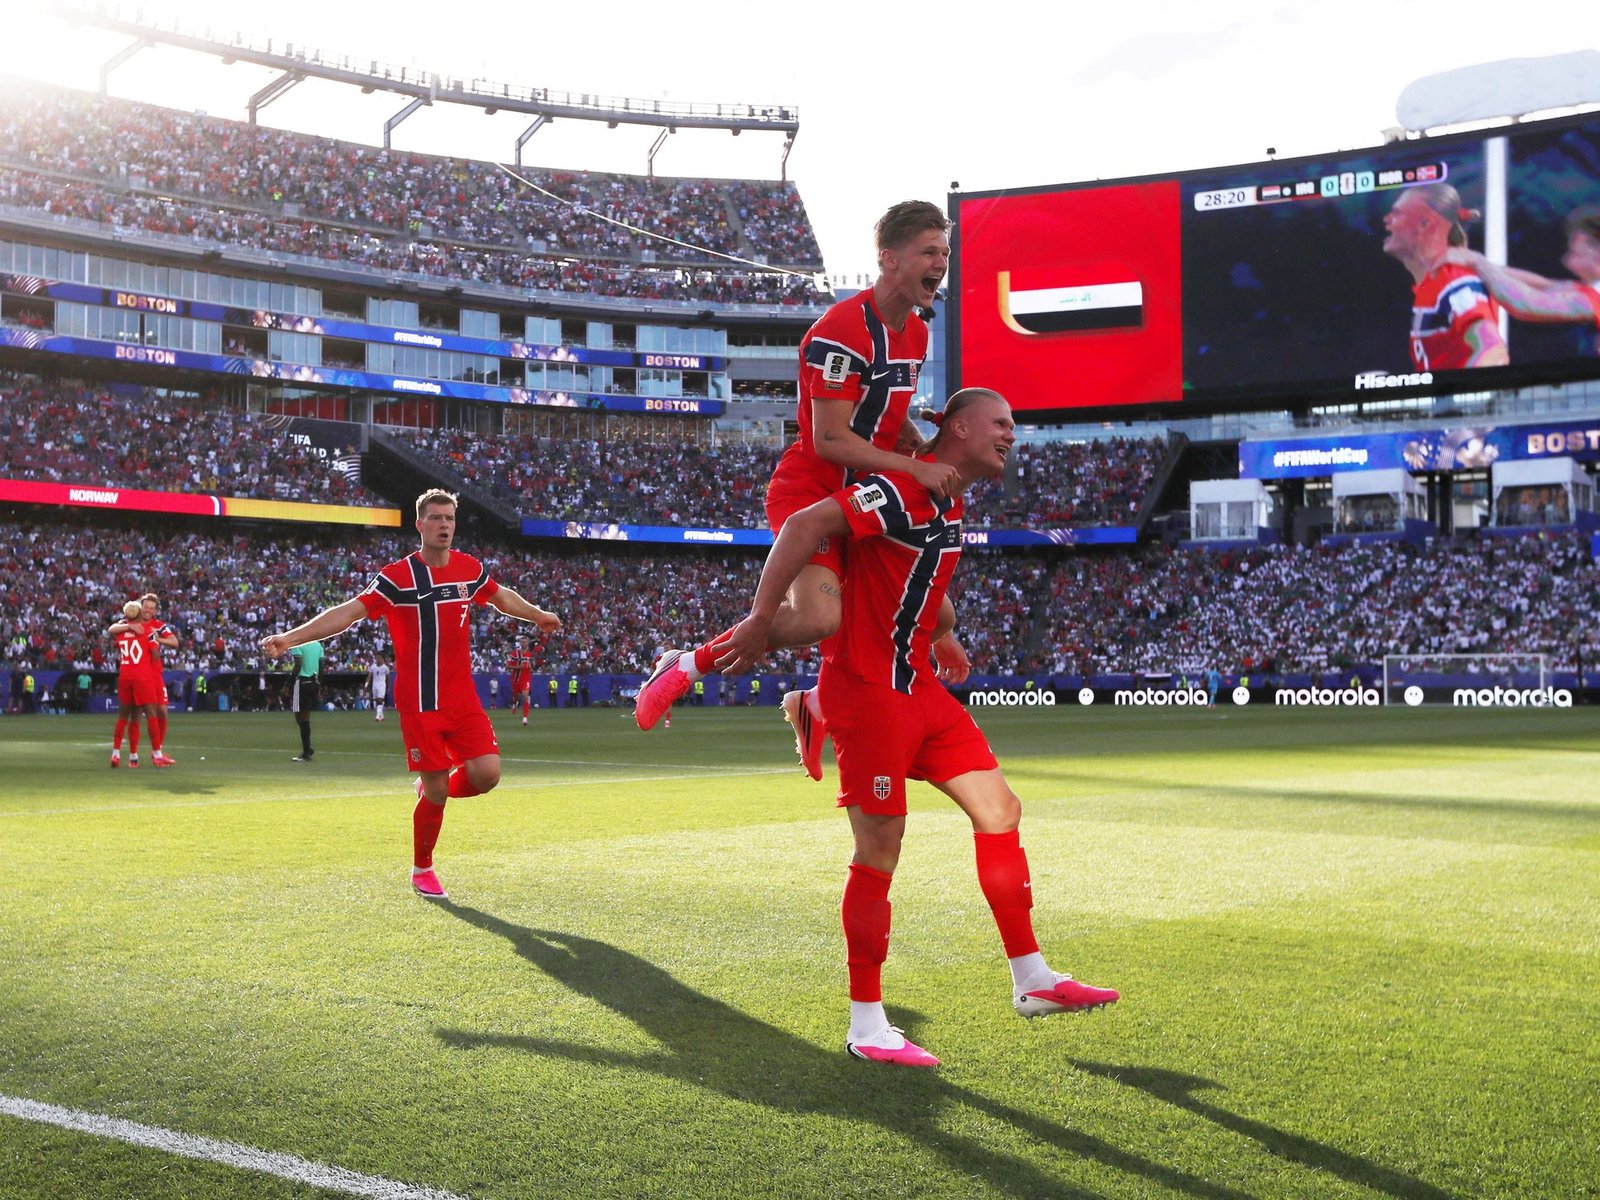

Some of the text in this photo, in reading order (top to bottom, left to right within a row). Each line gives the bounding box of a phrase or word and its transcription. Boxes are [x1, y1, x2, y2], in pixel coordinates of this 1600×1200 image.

[1204, 190, 1246, 207] 28:20
[1325, 180, 1334, 192] 0
[1361, 175, 1370, 188] 0
[116, 292, 177, 313] BOSTON
[115, 344, 176, 365] BOSTON
[645, 355, 700, 368] BOSTON
[1354, 372, 1434, 390] Hisense
[645, 399, 700, 412] BOSTON
[1527, 430, 1600, 455] BOST
[69, 488, 119, 504] NORWAY
[961, 532, 988, 544] TON
[459, 604, 469, 628] 7
[969, 688, 1056, 706] motorola
[1114, 687, 1208, 706] motorola
[1275, 685, 1379, 706] motorola
[1453, 685, 1573, 708] motorola
